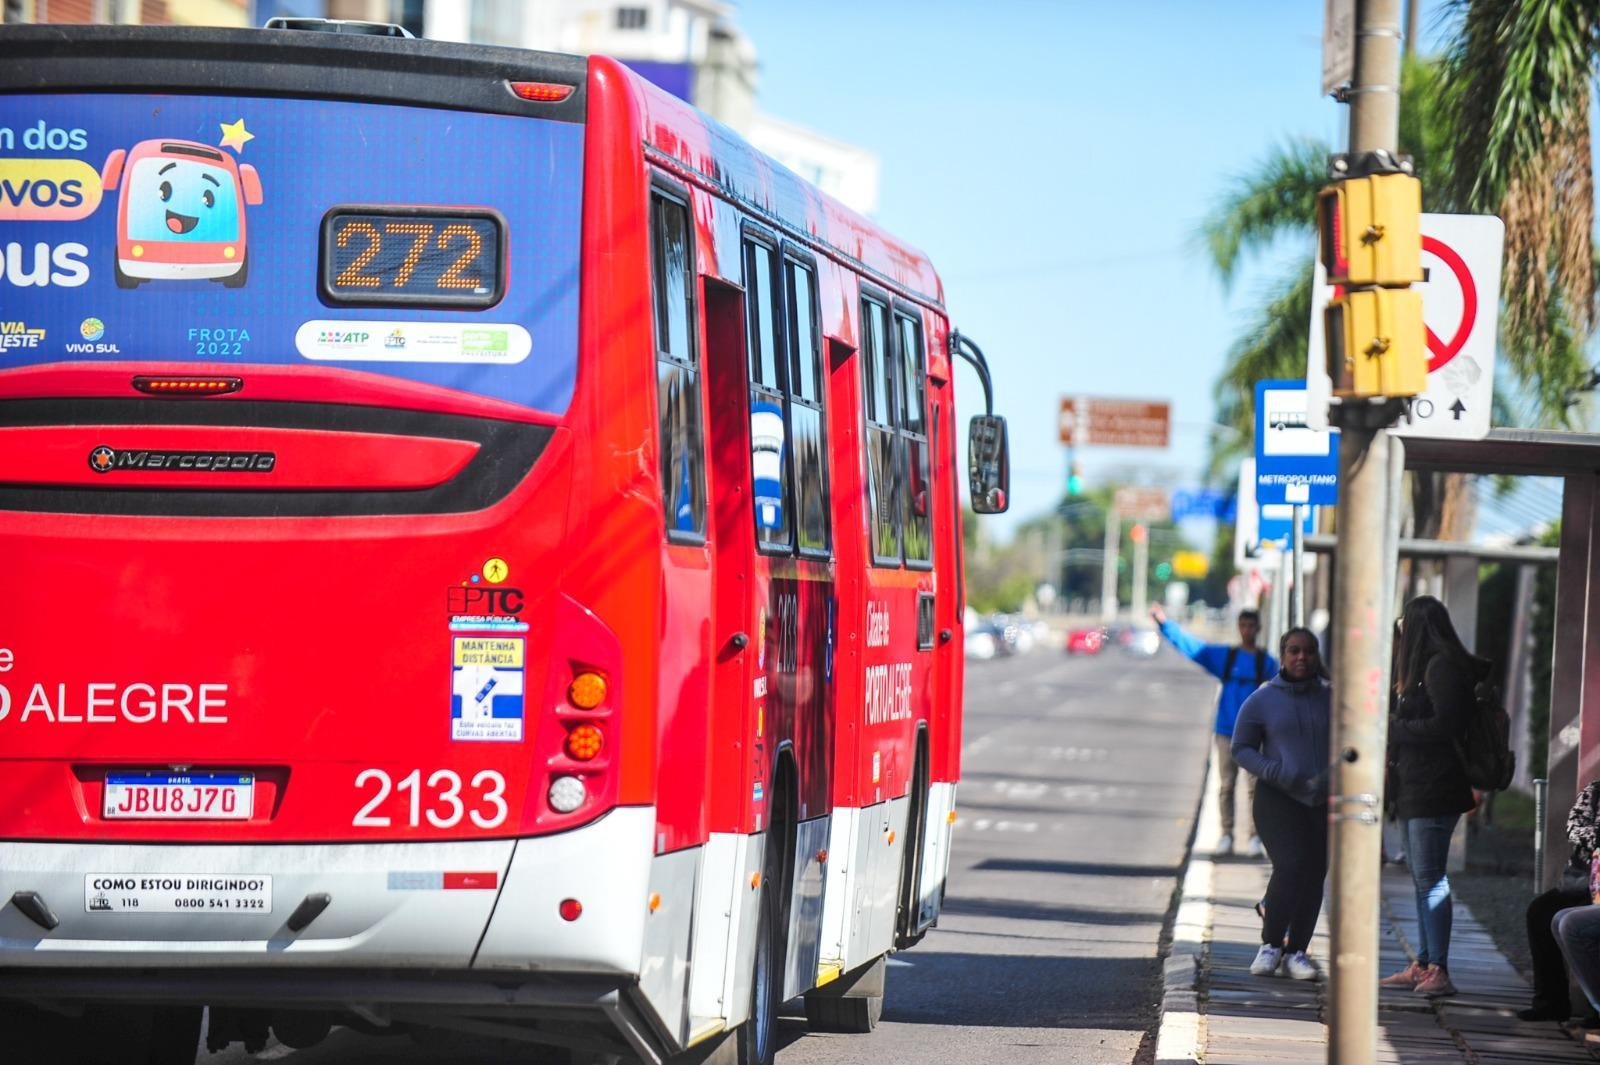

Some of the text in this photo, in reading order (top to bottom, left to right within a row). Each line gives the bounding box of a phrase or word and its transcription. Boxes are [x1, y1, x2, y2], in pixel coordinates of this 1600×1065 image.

[23, 119, 88, 150] dos
[0, 179, 83, 207] vos
[336, 222, 480, 289] 272
[0, 242, 90, 287] us
[0, 321, 25, 334] VIA
[188, 328, 250, 341] FROTA
[343, 332, 370, 343] ATP
[96, 343, 120, 354] SUL
[195, 342, 242, 355] 2022
[118, 451, 275, 471] Marcopolo
[1258, 474, 1336, 486] METROPOLITANO
[461, 641, 516, 651] MANTENHA
[462, 651, 514, 664] DISTÂNCIA
[20, 683, 228, 723] ALEGRE
[118, 787, 236, 812] JBU8J70
[352, 768, 508, 829] 2133
[93, 879, 264, 891] COMO ESTOU DIRIGINDO?
[121, 898, 264, 909] 118 0800 541 3322
